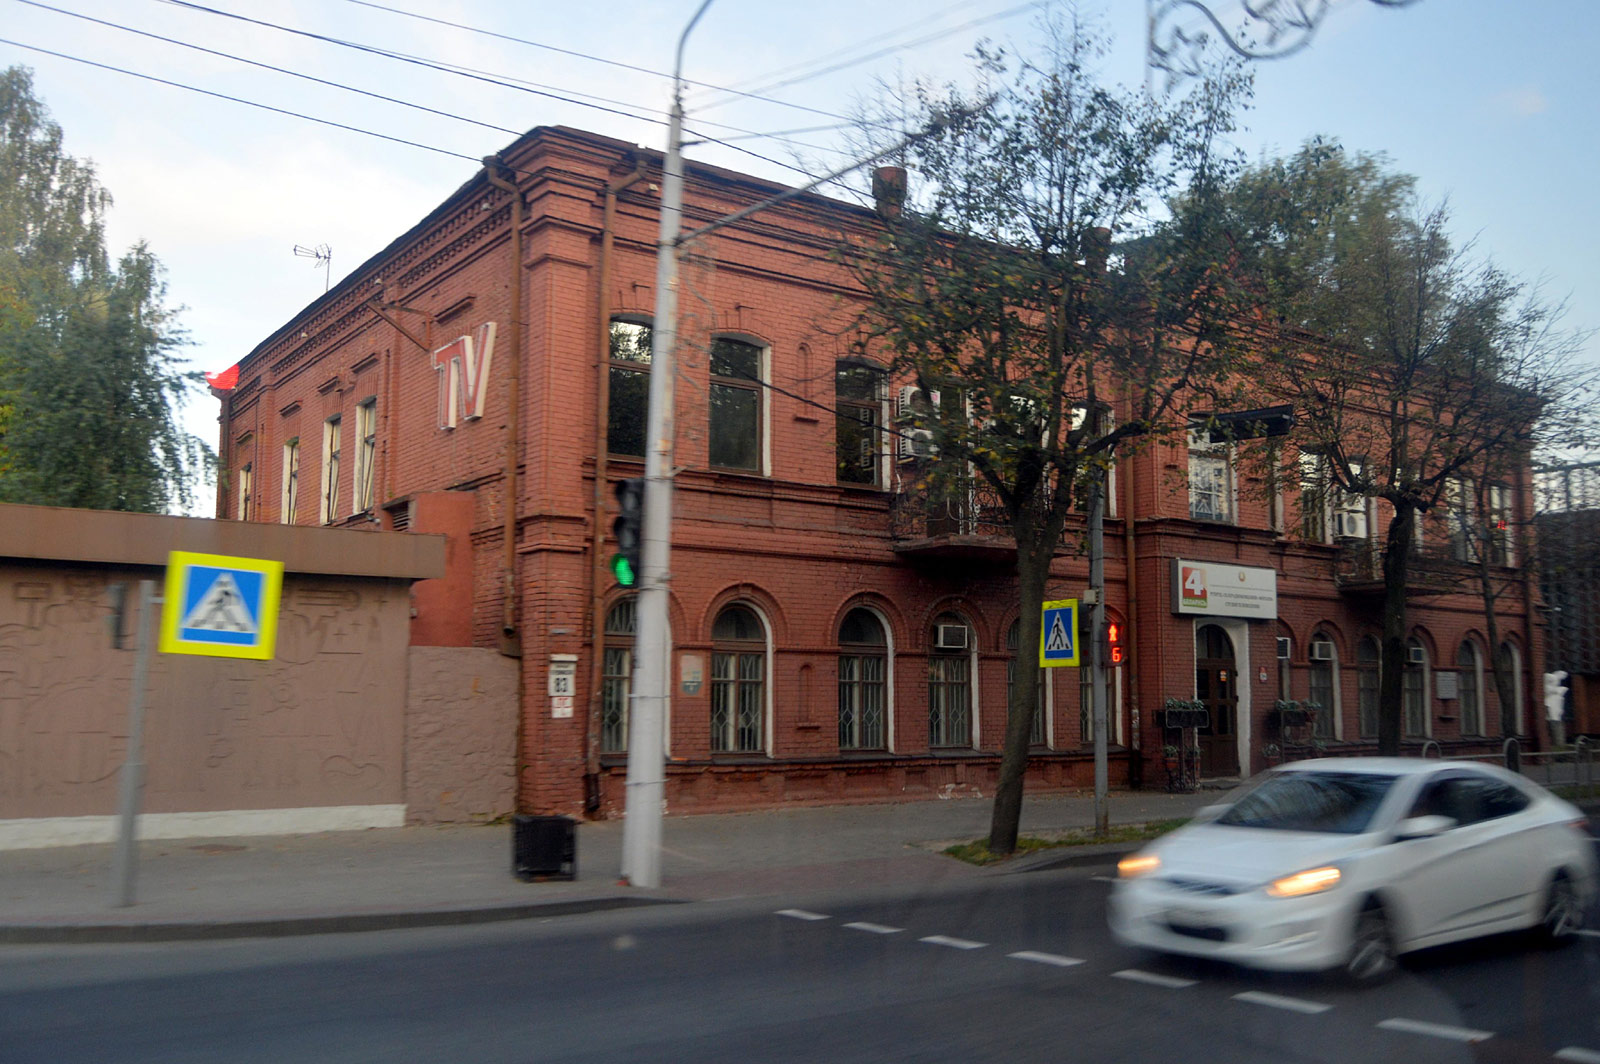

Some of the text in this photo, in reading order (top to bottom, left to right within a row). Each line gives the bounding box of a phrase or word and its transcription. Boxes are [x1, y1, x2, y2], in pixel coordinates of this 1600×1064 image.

[433, 322, 497, 430] TV
[1185, 569, 1204, 596] 4
[1112, 647, 1122, 662] 6
